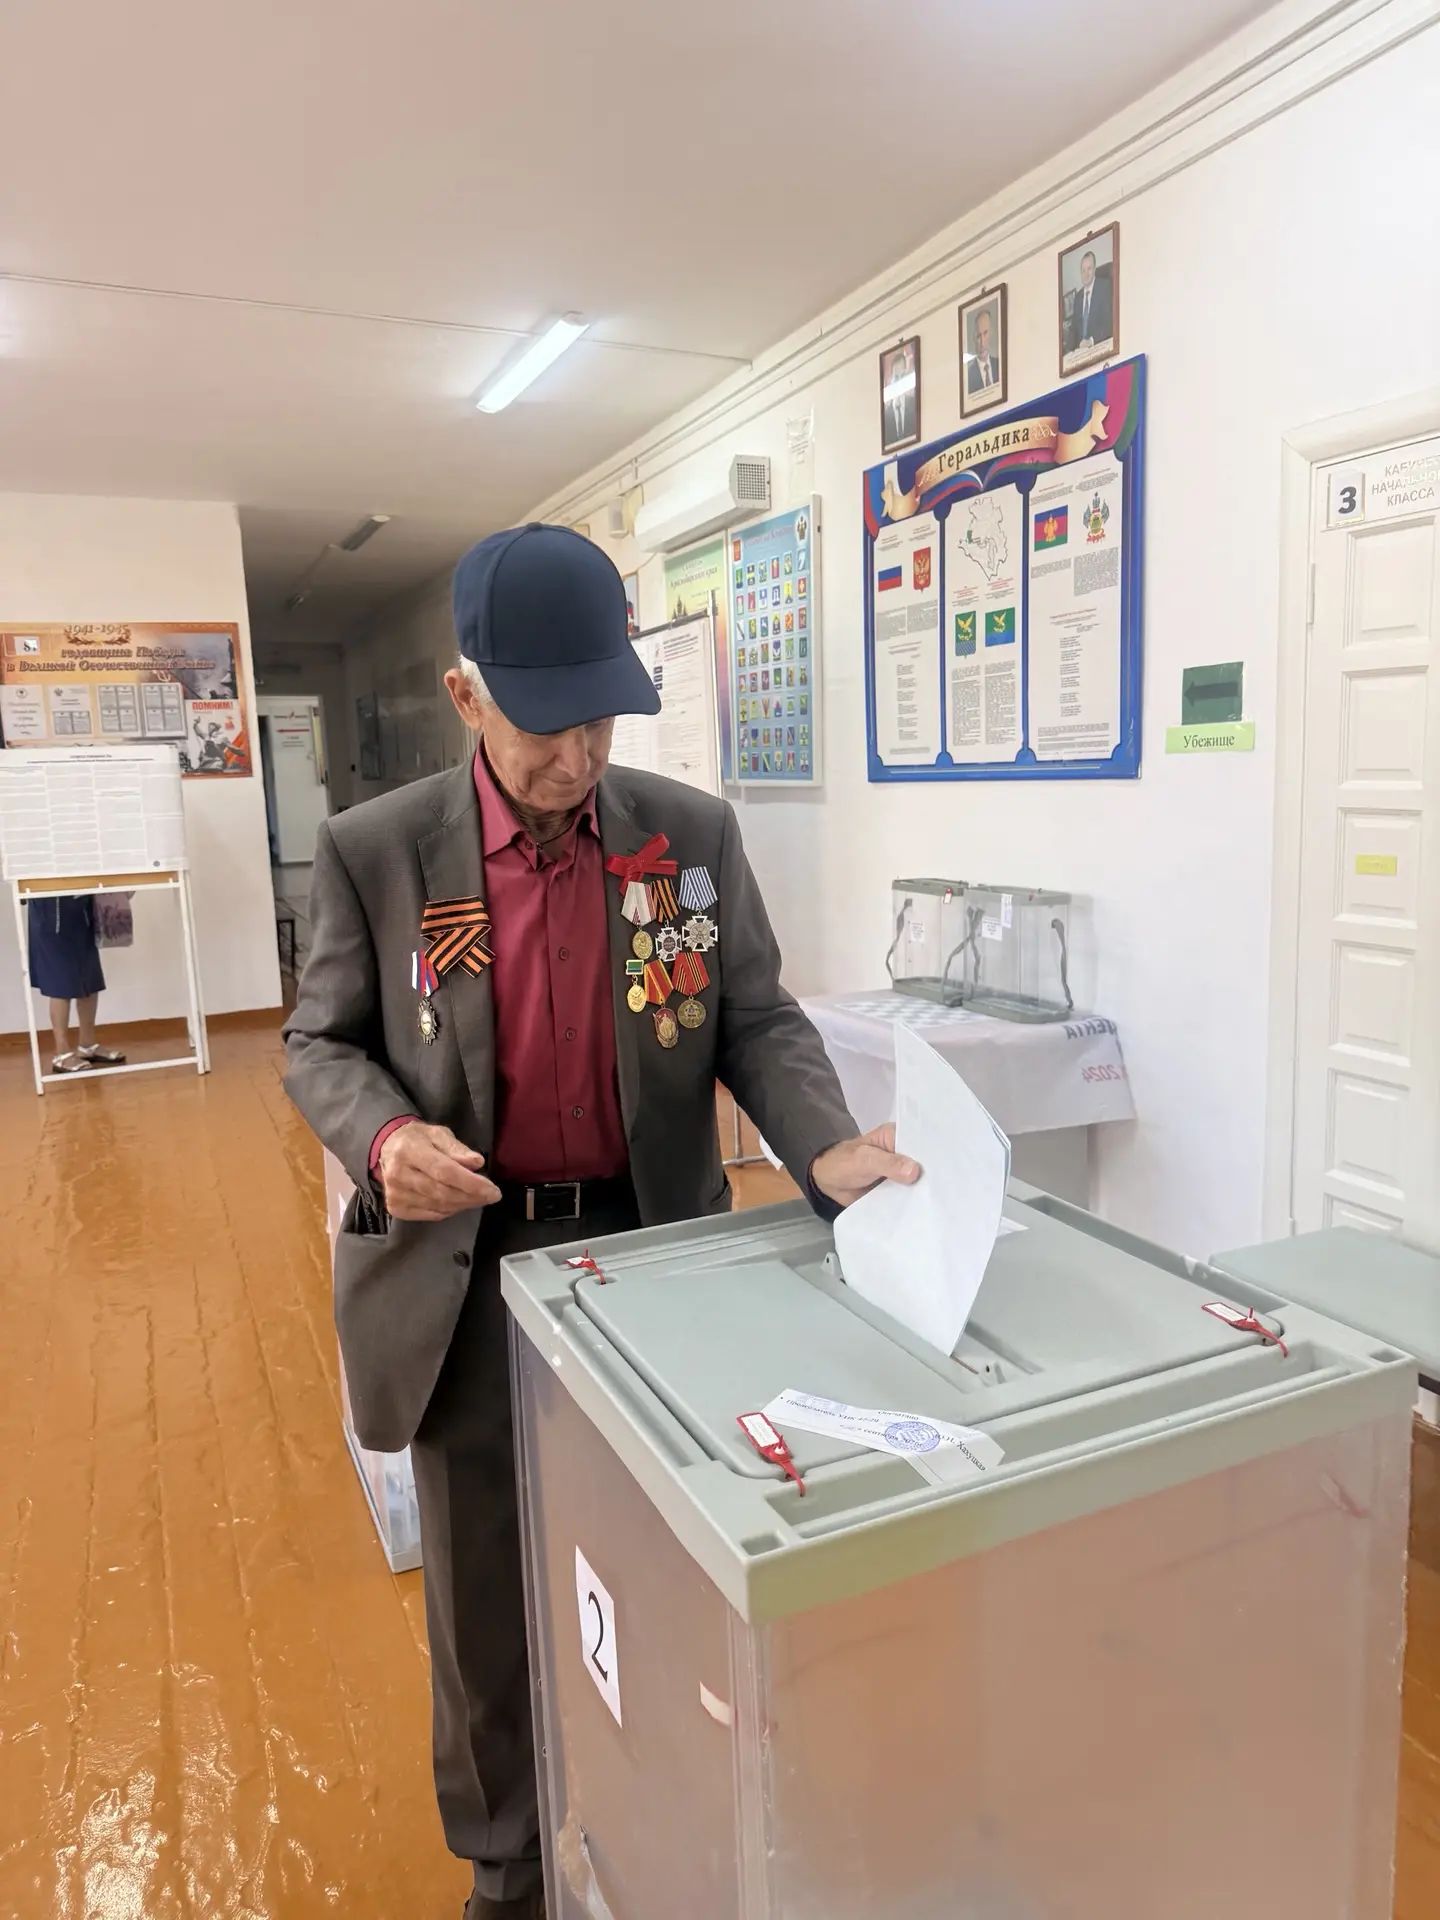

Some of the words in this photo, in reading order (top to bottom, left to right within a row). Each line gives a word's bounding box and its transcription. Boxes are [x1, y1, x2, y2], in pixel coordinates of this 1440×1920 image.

[938, 427, 1030, 473] Геральдика
[1338, 486, 1357, 514] 3
[1387, 487, 1434, 507] КЛАССА
[1183, 735, 1235, 749] Убежище
[588, 1591, 604, 1683] 2
